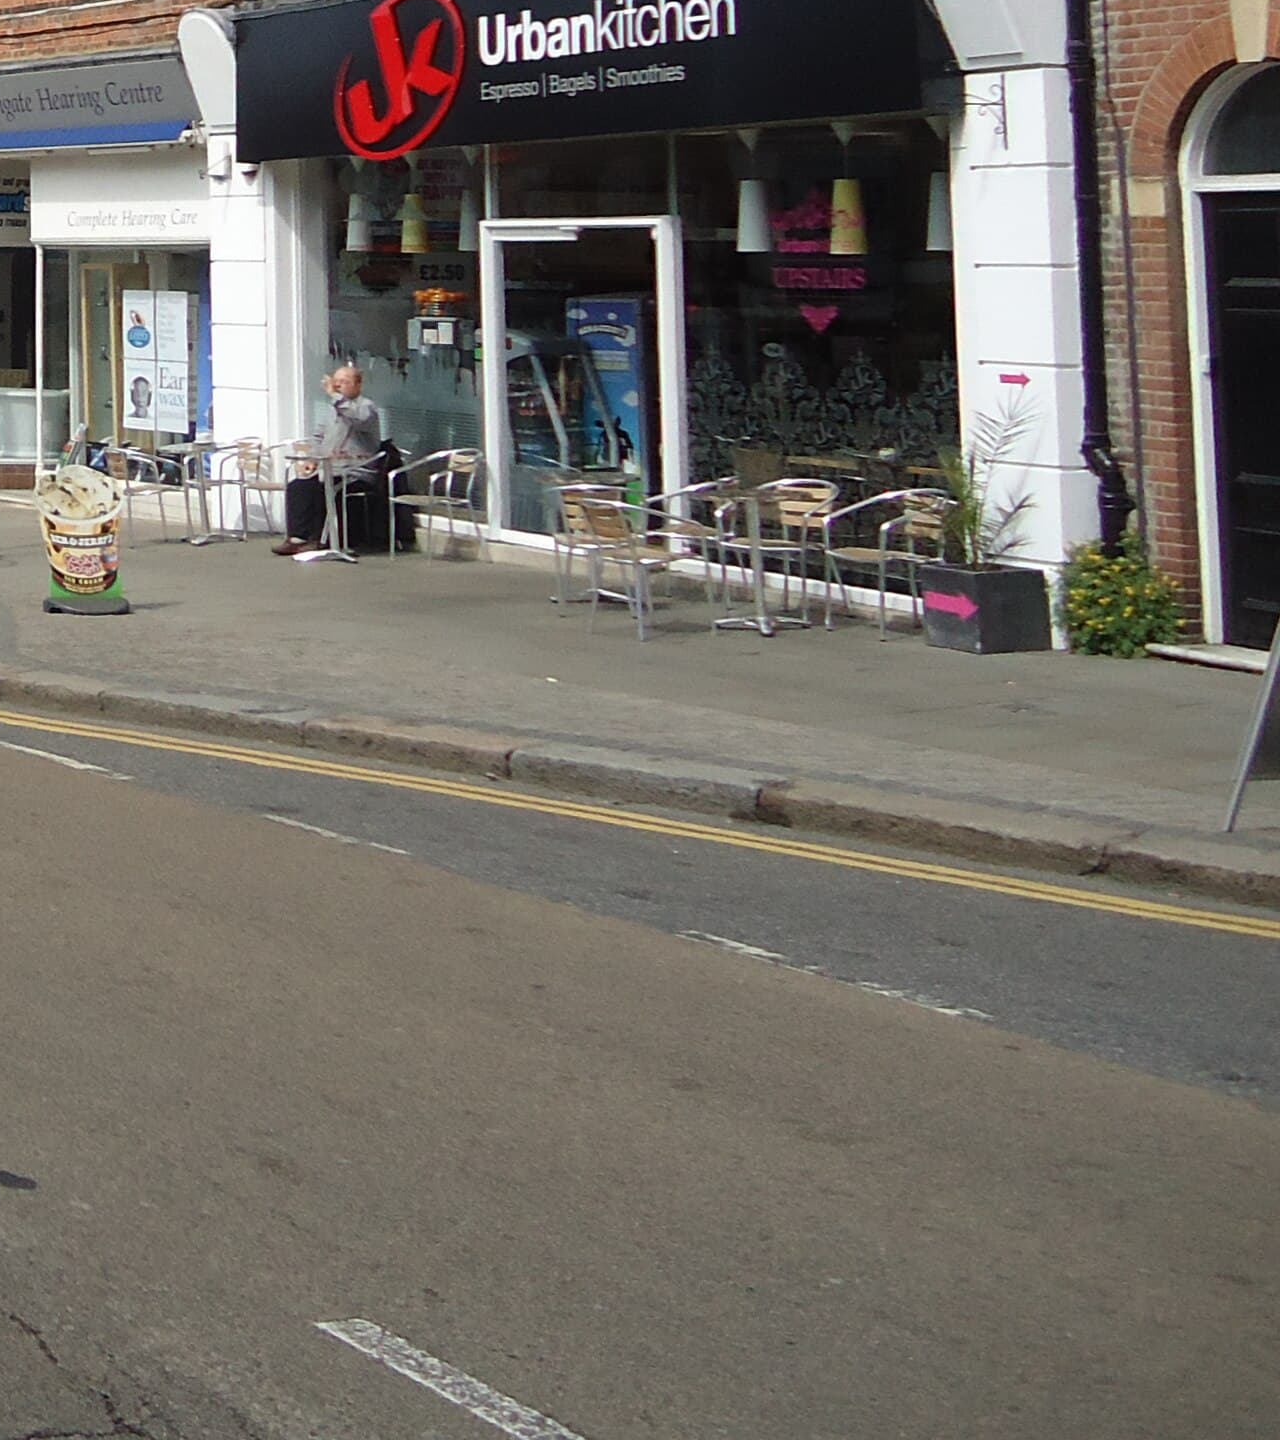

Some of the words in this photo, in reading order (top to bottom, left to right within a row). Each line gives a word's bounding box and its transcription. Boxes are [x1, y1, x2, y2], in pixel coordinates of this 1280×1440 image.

[480, 81, 538, 103] Espresso
[550, 71, 596, 96] Bagels
[606, 63, 685, 88] Smoothies
[36, 85, 102, 115] Hearing
[104, 82, 163, 107] Centre
[67, 211, 118, 231] Complete
[121, 210, 167, 229] Hearing
[171, 209, 198, 225] Care
[159, 367, 186, 390] Ear
[159, 394, 185, 407] wax
